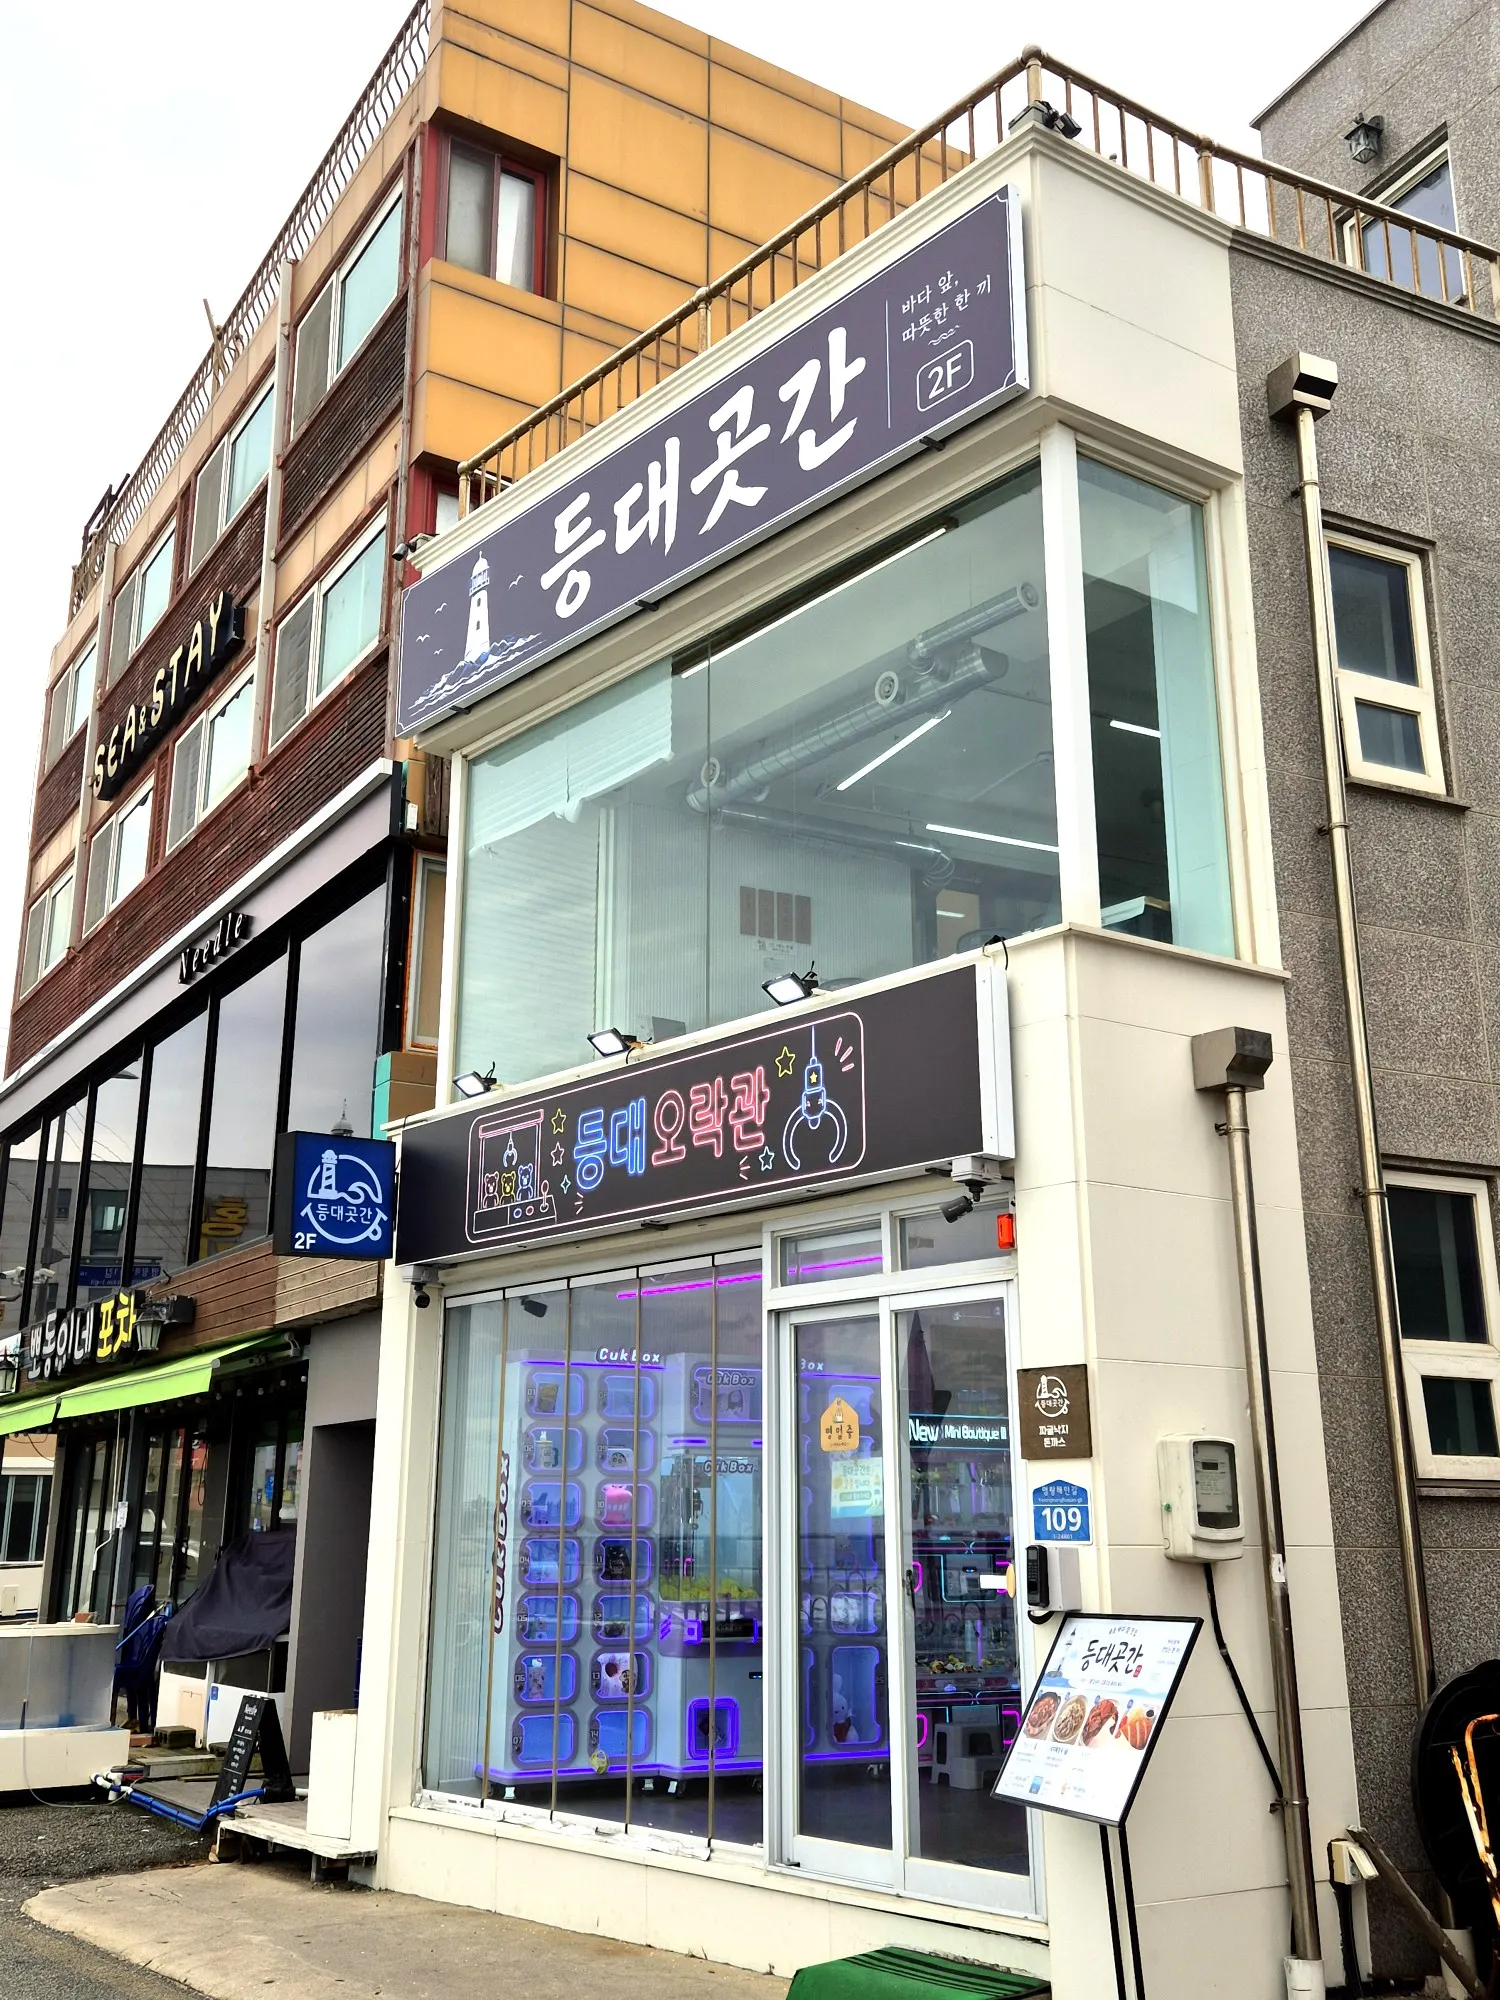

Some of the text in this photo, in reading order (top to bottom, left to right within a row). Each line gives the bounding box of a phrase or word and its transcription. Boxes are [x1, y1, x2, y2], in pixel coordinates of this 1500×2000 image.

[901, 270, 959, 314] 바다 앞,
[902, 274, 991, 342] 따뜻한 한 끼
[927, 352, 962, 400] 2F
[540, 326, 866, 619] 등대곳간
[178, 912, 244, 984] Needle
[315, 1203, 373, 1225] 등대곳간
[294, 1231, 318, 1250] 2F
[96, 1291, 137, 1359] 포차
[825, 1424, 853, 1440] 영업중
[908, 1418, 939, 1442] New
[961, 1424, 999, 1442] Boutique
[1043, 1437, 1067, 1448] 돈까스
[1041, 1507, 1082, 1532] 109
[1082, 1640, 1144, 1674] 등대곳간
